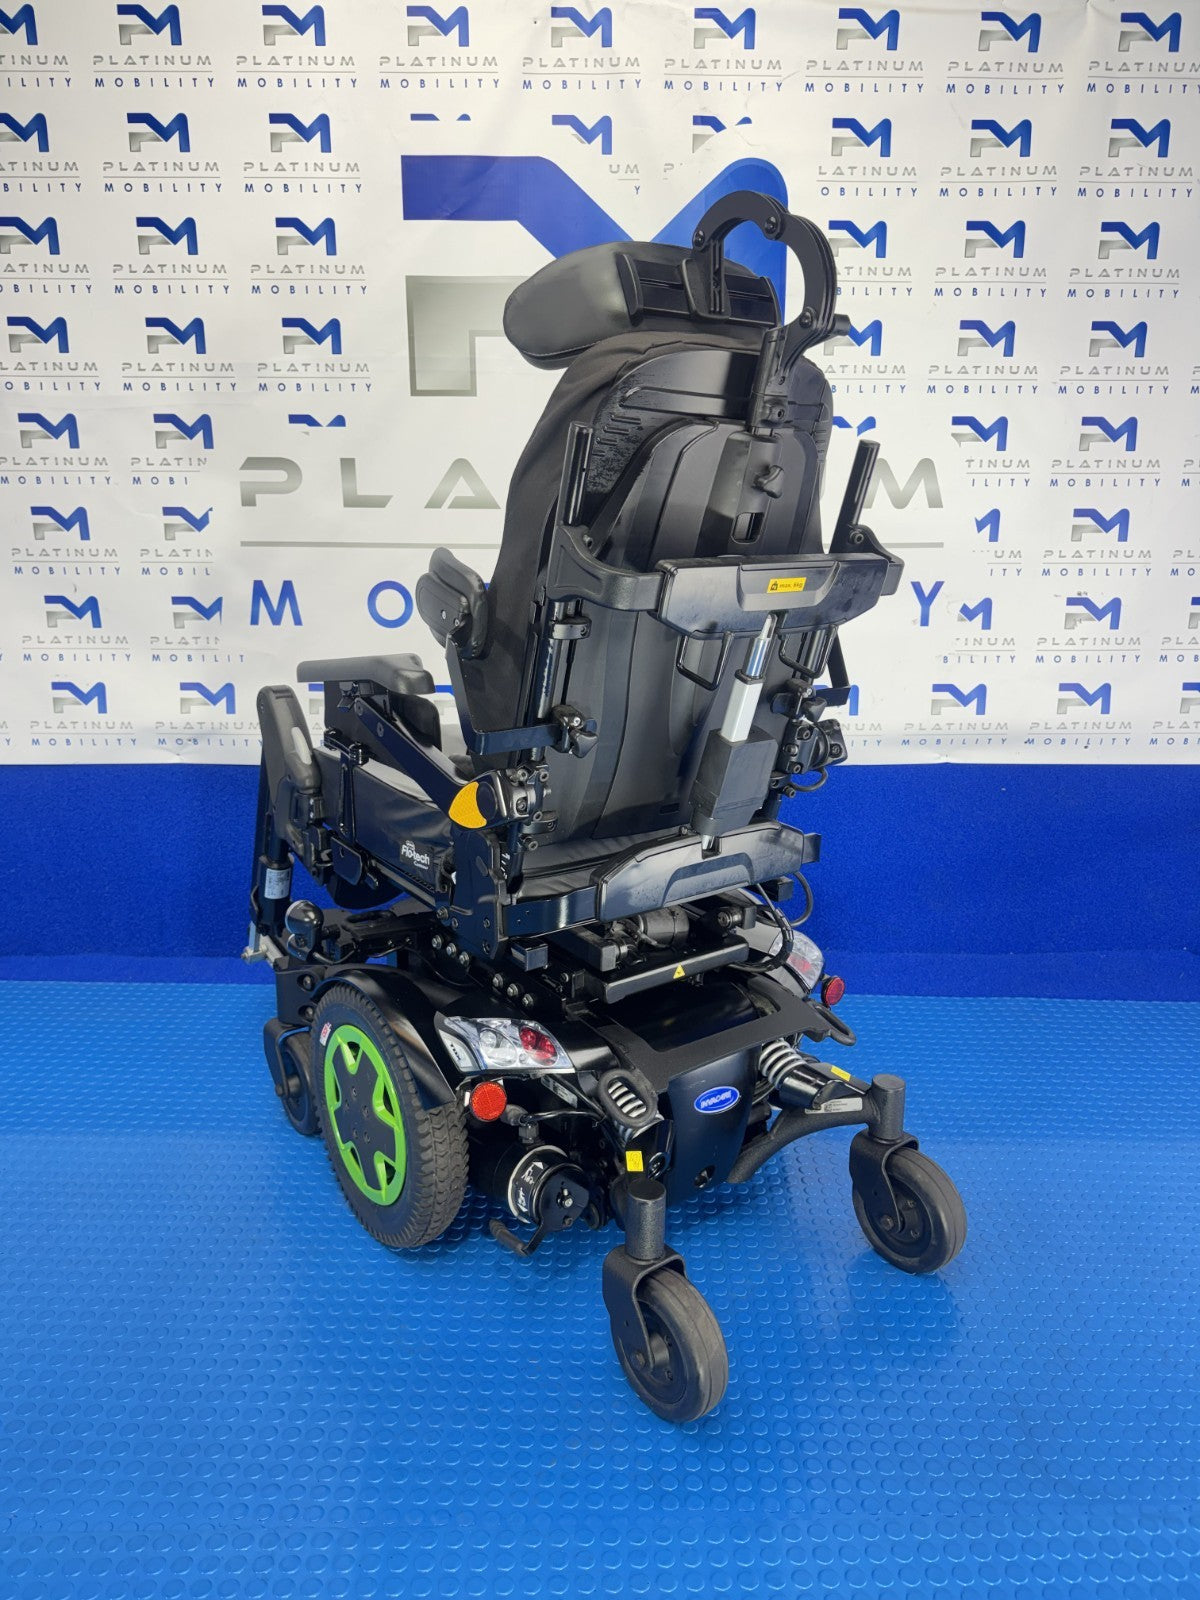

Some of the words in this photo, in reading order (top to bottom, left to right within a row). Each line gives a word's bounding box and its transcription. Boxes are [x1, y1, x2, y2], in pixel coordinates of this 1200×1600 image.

[93, 55, 211, 65] PLATINUM
[237, 56, 354, 66] PLATINUM
[380, 56, 497, 66] PLATINUM
[523, 57, 639, 68] PLATINUM
[665, 59, 781, 70] PLATINUM
[807, 60, 923, 71] PLATINUM
[948, 62, 1063, 73] PLATINUM
[1089, 61, 1200, 72] PLATINUM
[95, 78, 213, 87] MOBILITY
[238, 78, 356, 87] MOBILITY
[380, 79, 499, 88] MOBILITY
[523, 79, 641, 89] MOBILITY
[664, 81, 782, 91] MOBILITY
[805, 83, 923, 92] MOBILITY
[947, 84, 1064, 94] MOBILITY
[103, 162, 219, 171] PLATINUM
[244, 162, 359, 172] PLATINUM
[941, 166, 1057, 176] PLATINUM
[1080, 165, 1193, 176] PLATINUM
[105, 183, 221, 192] MOBILITY
[245, 184, 361, 193] MOBILITY
[940, 187, 1056, 196] MOBILITY
[1078, 188, 1192, 197] MOBILITY
[113, 264, 226, 273] PLATINUM
[251, 265, 364, 274] PLATINUM
[836, 267, 911, 276] TINUM
[936, 267, 1046, 277] PLATINUM
[1070, 268, 1179, 278] PLATINUM
[115, 285, 228, 294] MOBILITY
[252, 285, 366, 294] MOBILITY
[934, 288, 1046, 297] MOBILITY
[1068, 289, 1178, 298] MOBILITY
[122, 363, 234, 372] PLATINUM
[258, 363, 369, 372] PLATINUM
[929, 365, 1037, 374] PLATINUM
[1060, 366, 1169, 375] PLATINUM
[124, 383, 236, 391] MOBILITY
[259, 383, 371, 391] MOBILITY
[927, 385, 1037, 393] MOBILITY
[1058, 386, 1168, 394] MOBILITY
[0, 457, 107, 465] PLATINUM
[1052, 459, 1160, 469] PLATINUM
[1, 476, 110, 484] MOBILITY
[1050, 479, 1160, 487] MOBILITY
[12, 548, 117, 557] PLATINUM
[1044, 550, 1151, 559] PLATINUM
[15, 567, 119, 575] MOBILITY
[1042, 568, 1151, 576] MOBILITY
[22, 636, 128, 644] PLATINUM
[1037, 637, 1141, 647] PLATINUM
[1036, 655, 1140, 663] MOBILITY
[30, 721, 133, 729] PLATINUM
[903, 723, 1007, 732] PLATINUM
[1027, 722, 1132, 731] PLATINUM
[32, 738, 136, 746] MOBILITY
[1028, 738, 1130, 746] MOBILITY
